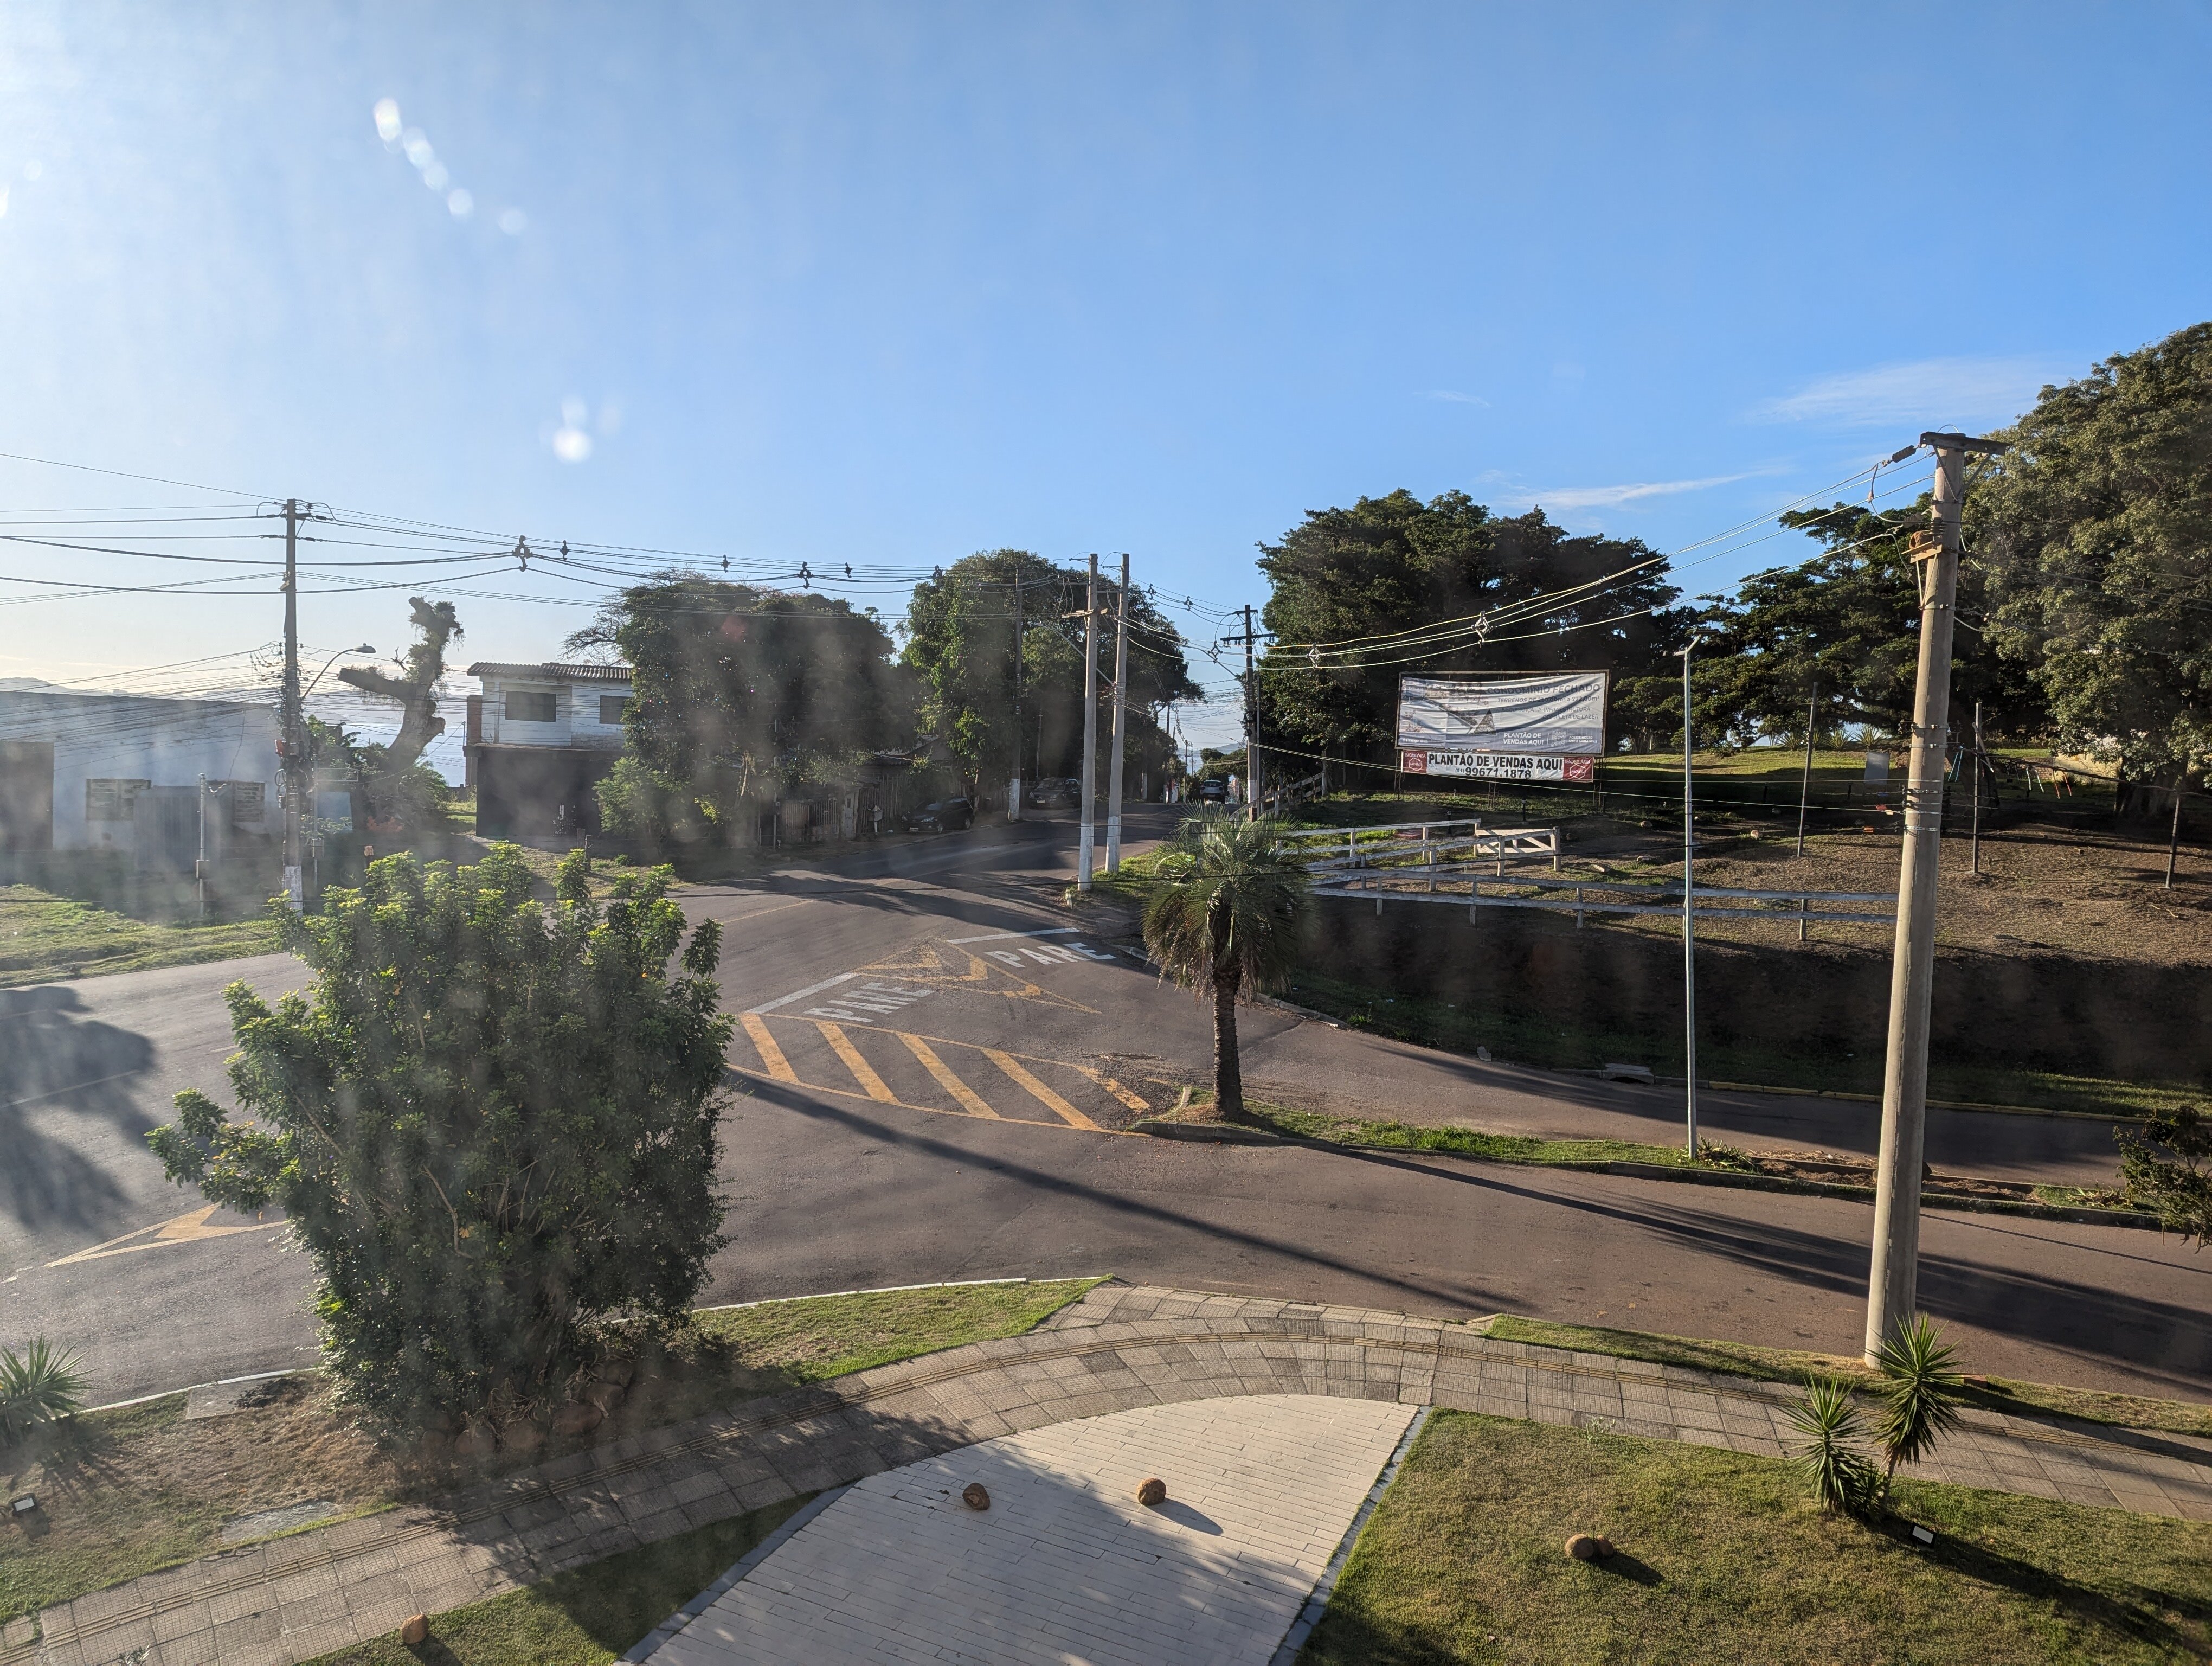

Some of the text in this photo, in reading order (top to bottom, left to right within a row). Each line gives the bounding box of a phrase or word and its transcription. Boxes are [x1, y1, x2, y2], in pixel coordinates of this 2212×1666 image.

[1488, 684, 1600, 694] CONDOMÍNIO FECHADO
[1429, 753, 1563, 771] PLANTÃO DE VENDAS AQUI
[984, 943, 1117, 968] PARE
[802, 982, 934, 1023] PARE
